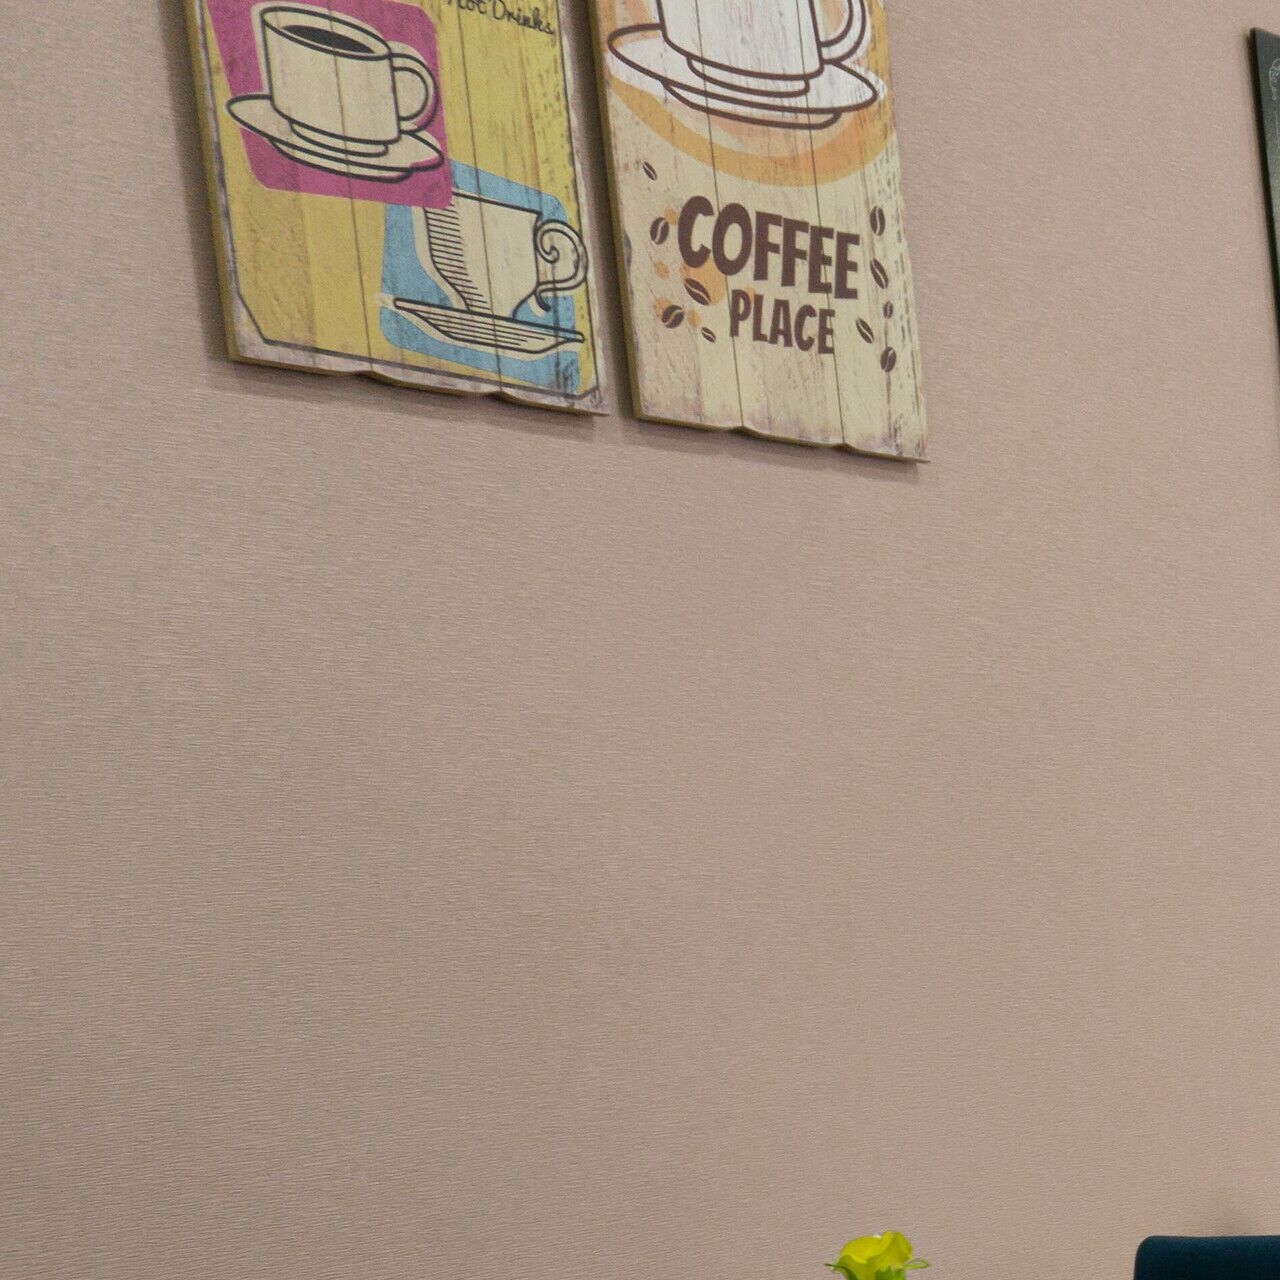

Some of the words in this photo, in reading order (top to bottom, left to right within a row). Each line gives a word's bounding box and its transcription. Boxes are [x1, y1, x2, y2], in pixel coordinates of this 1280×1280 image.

[492, 0, 555, 35] Drinks
[677, 195, 860, 299] COFFEE
[729, 288, 836, 354] PLACE
